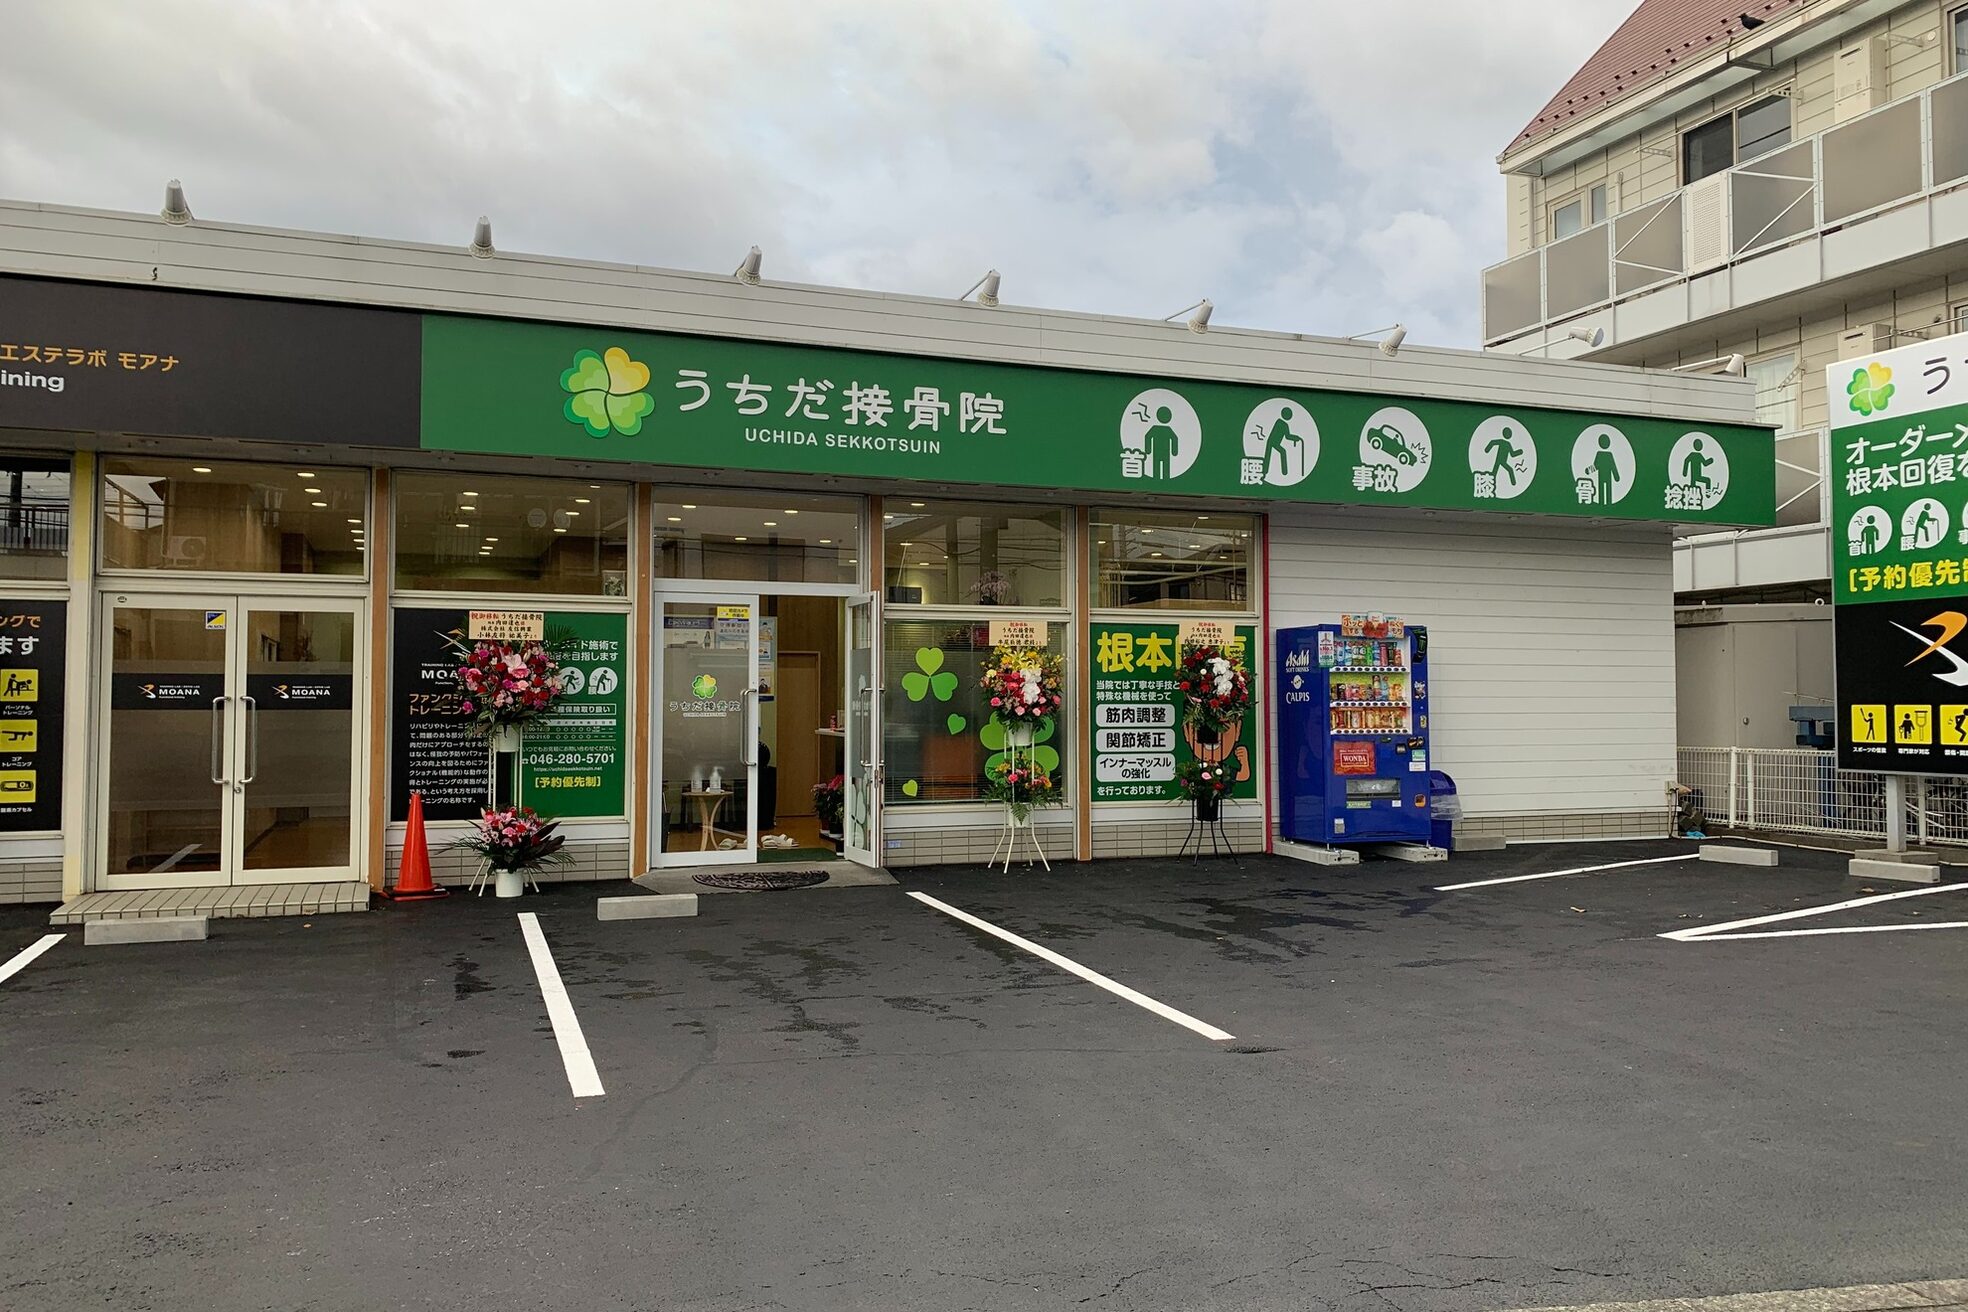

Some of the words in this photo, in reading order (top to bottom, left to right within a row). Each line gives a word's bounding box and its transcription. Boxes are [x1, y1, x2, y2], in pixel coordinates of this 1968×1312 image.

[0, 345, 107, 367] エステラボ
[118, 352, 180, 372] モアナ
[1923, 357, 1968, 395] う
[675, 368, 1007, 435] うちだ接骨院
[744, 427, 818, 446] UCHIDA
[825, 433, 941, 454] SEKKOTSUIN
[1120, 450, 1144, 478] 首
[1240, 458, 1264, 485] 腰
[1352, 465, 1397, 492] 事故
[1473, 473, 1496, 499] 膝
[1575, 480, 1596, 504] 骨
[1664, 486, 1703, 510] 捻挫
[1850, 559, 1968, 592] [予約優先
[1285, 649, 1310, 667] Asahi
[421, 670, 460, 679] MOA
[1096, 680, 1180, 690] 当院では丁寧な手技と
[1096, 691, 1172, 701] 特殊な機械を使って
[1286, 691, 1310, 704] CALPIS
[409, 705, 462, 715] トレーニン
[669, 700, 741, 712] うちだ接骨院
[1105, 707, 1166, 724] 筋肉調整
[1106, 732, 1166, 748] 関節矯正
[530, 753, 615, 765] 046-280-5701
[1099, 757, 1171, 768] インナーマッスル
[1121, 767, 1150, 779] の強化
[1097, 785, 1167, 796] を行っております。
